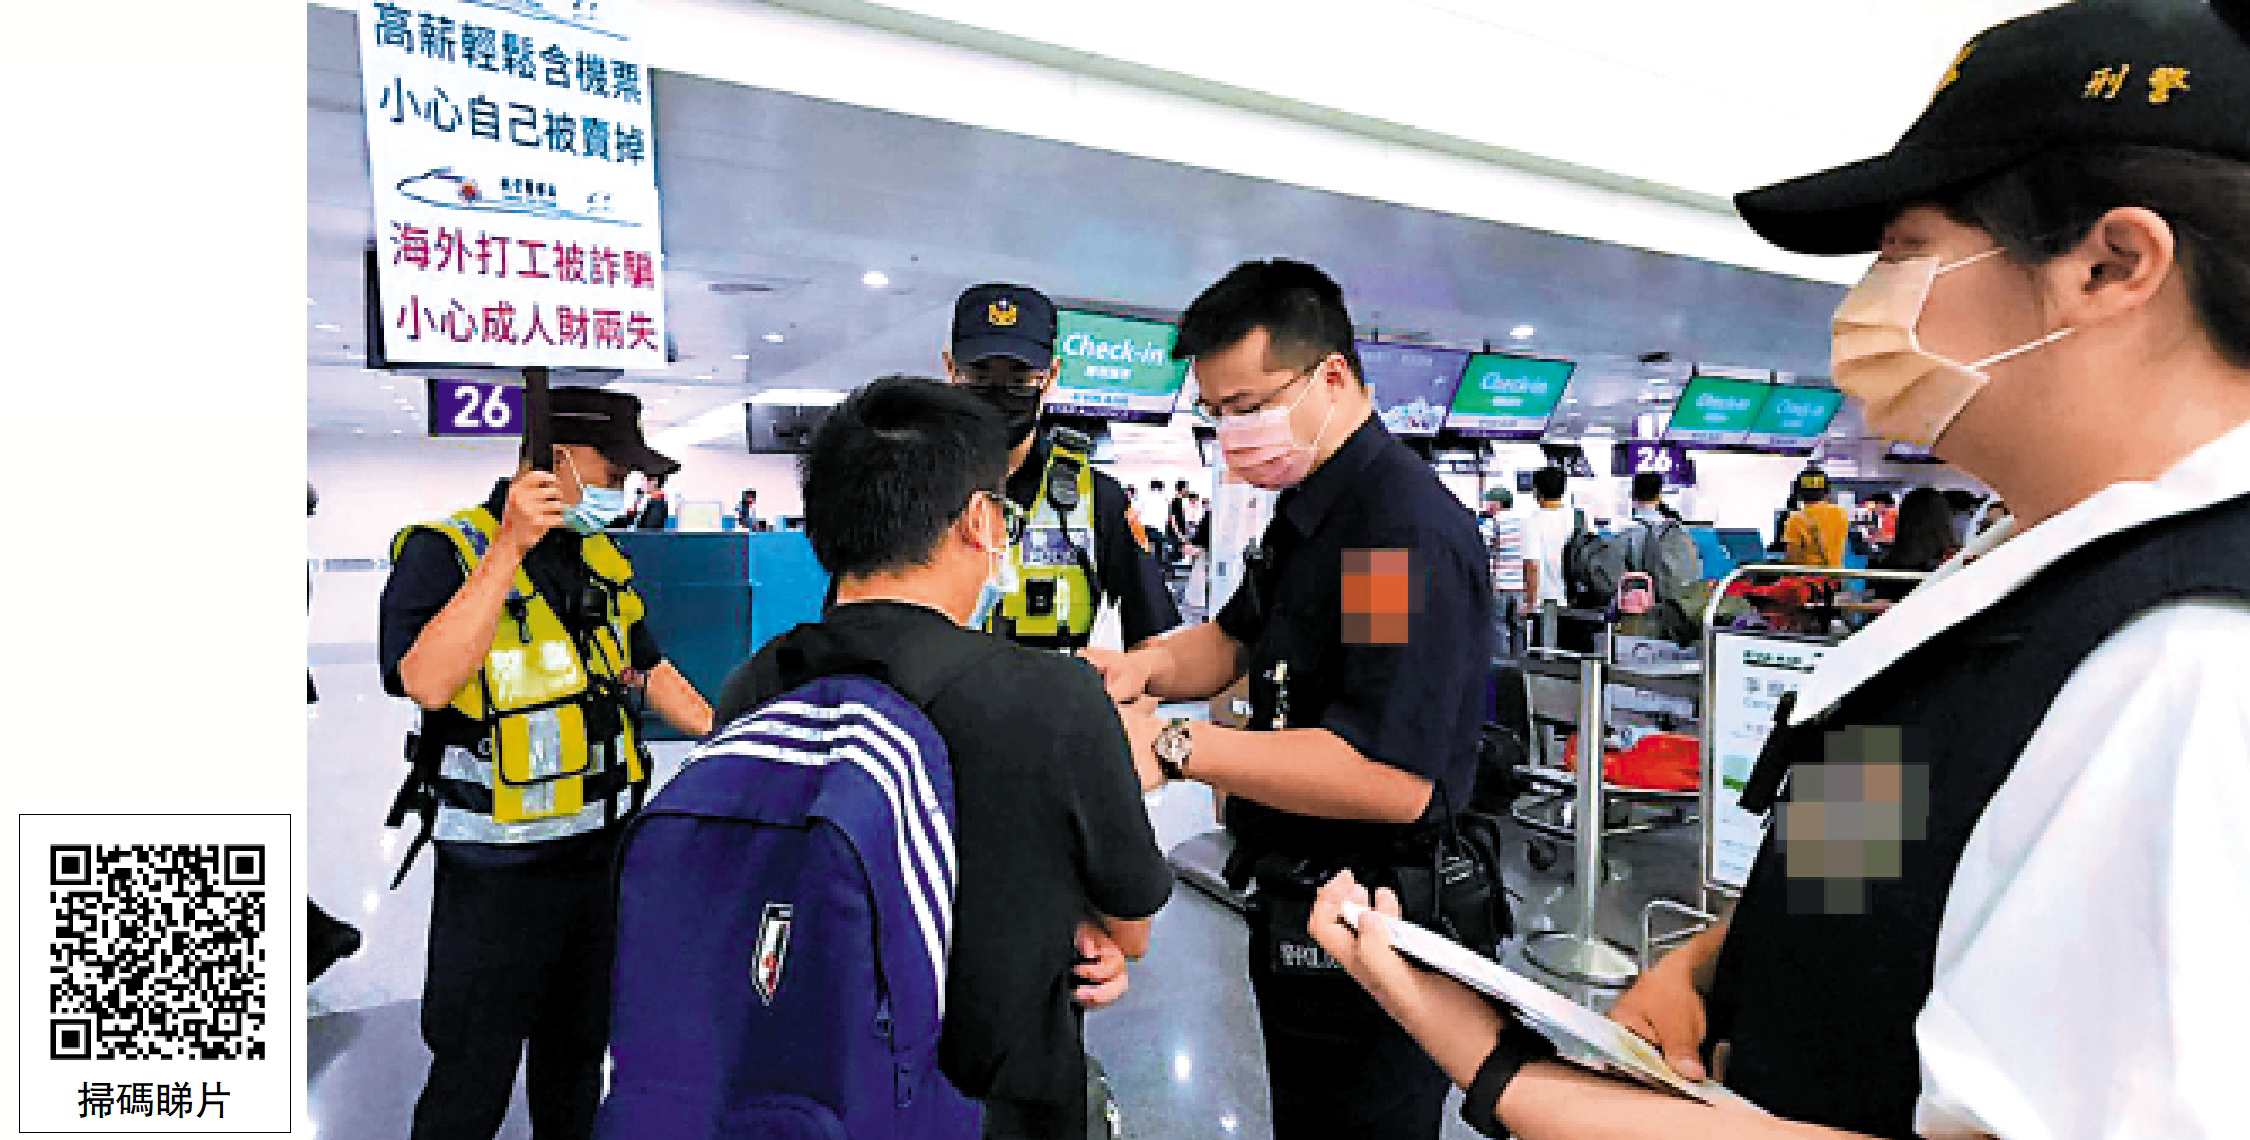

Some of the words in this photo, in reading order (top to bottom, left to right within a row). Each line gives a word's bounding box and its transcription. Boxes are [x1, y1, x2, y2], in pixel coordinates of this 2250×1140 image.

[380, 77, 645, 166] 小心自己被賣掉
[390, 220, 655, 290] 海外打工被詐騙
[396, 295, 659, 352] 小心成人財兩失
[1062, 331, 1165, 367] Check-in
[452, 385, 511, 428] 26
[1635, 446, 1672, 473] 26
